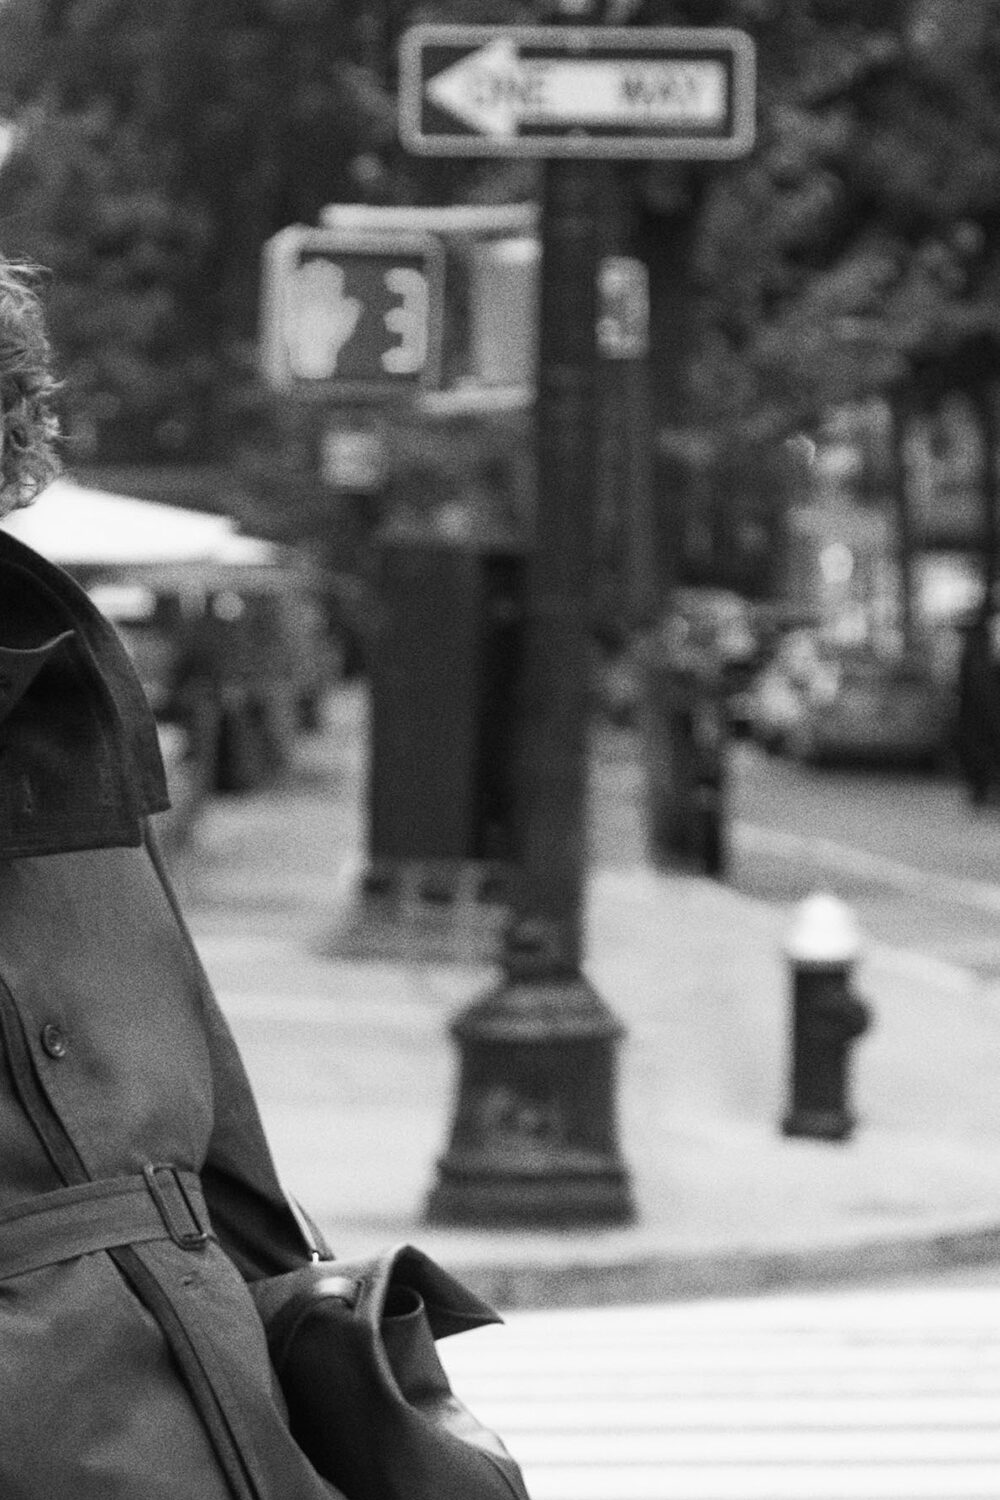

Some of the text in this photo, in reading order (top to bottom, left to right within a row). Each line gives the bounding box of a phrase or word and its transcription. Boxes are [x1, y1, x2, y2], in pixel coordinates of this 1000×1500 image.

[468, 72, 711, 108] ONE WAY
[382, 266, 429, 374] 3
